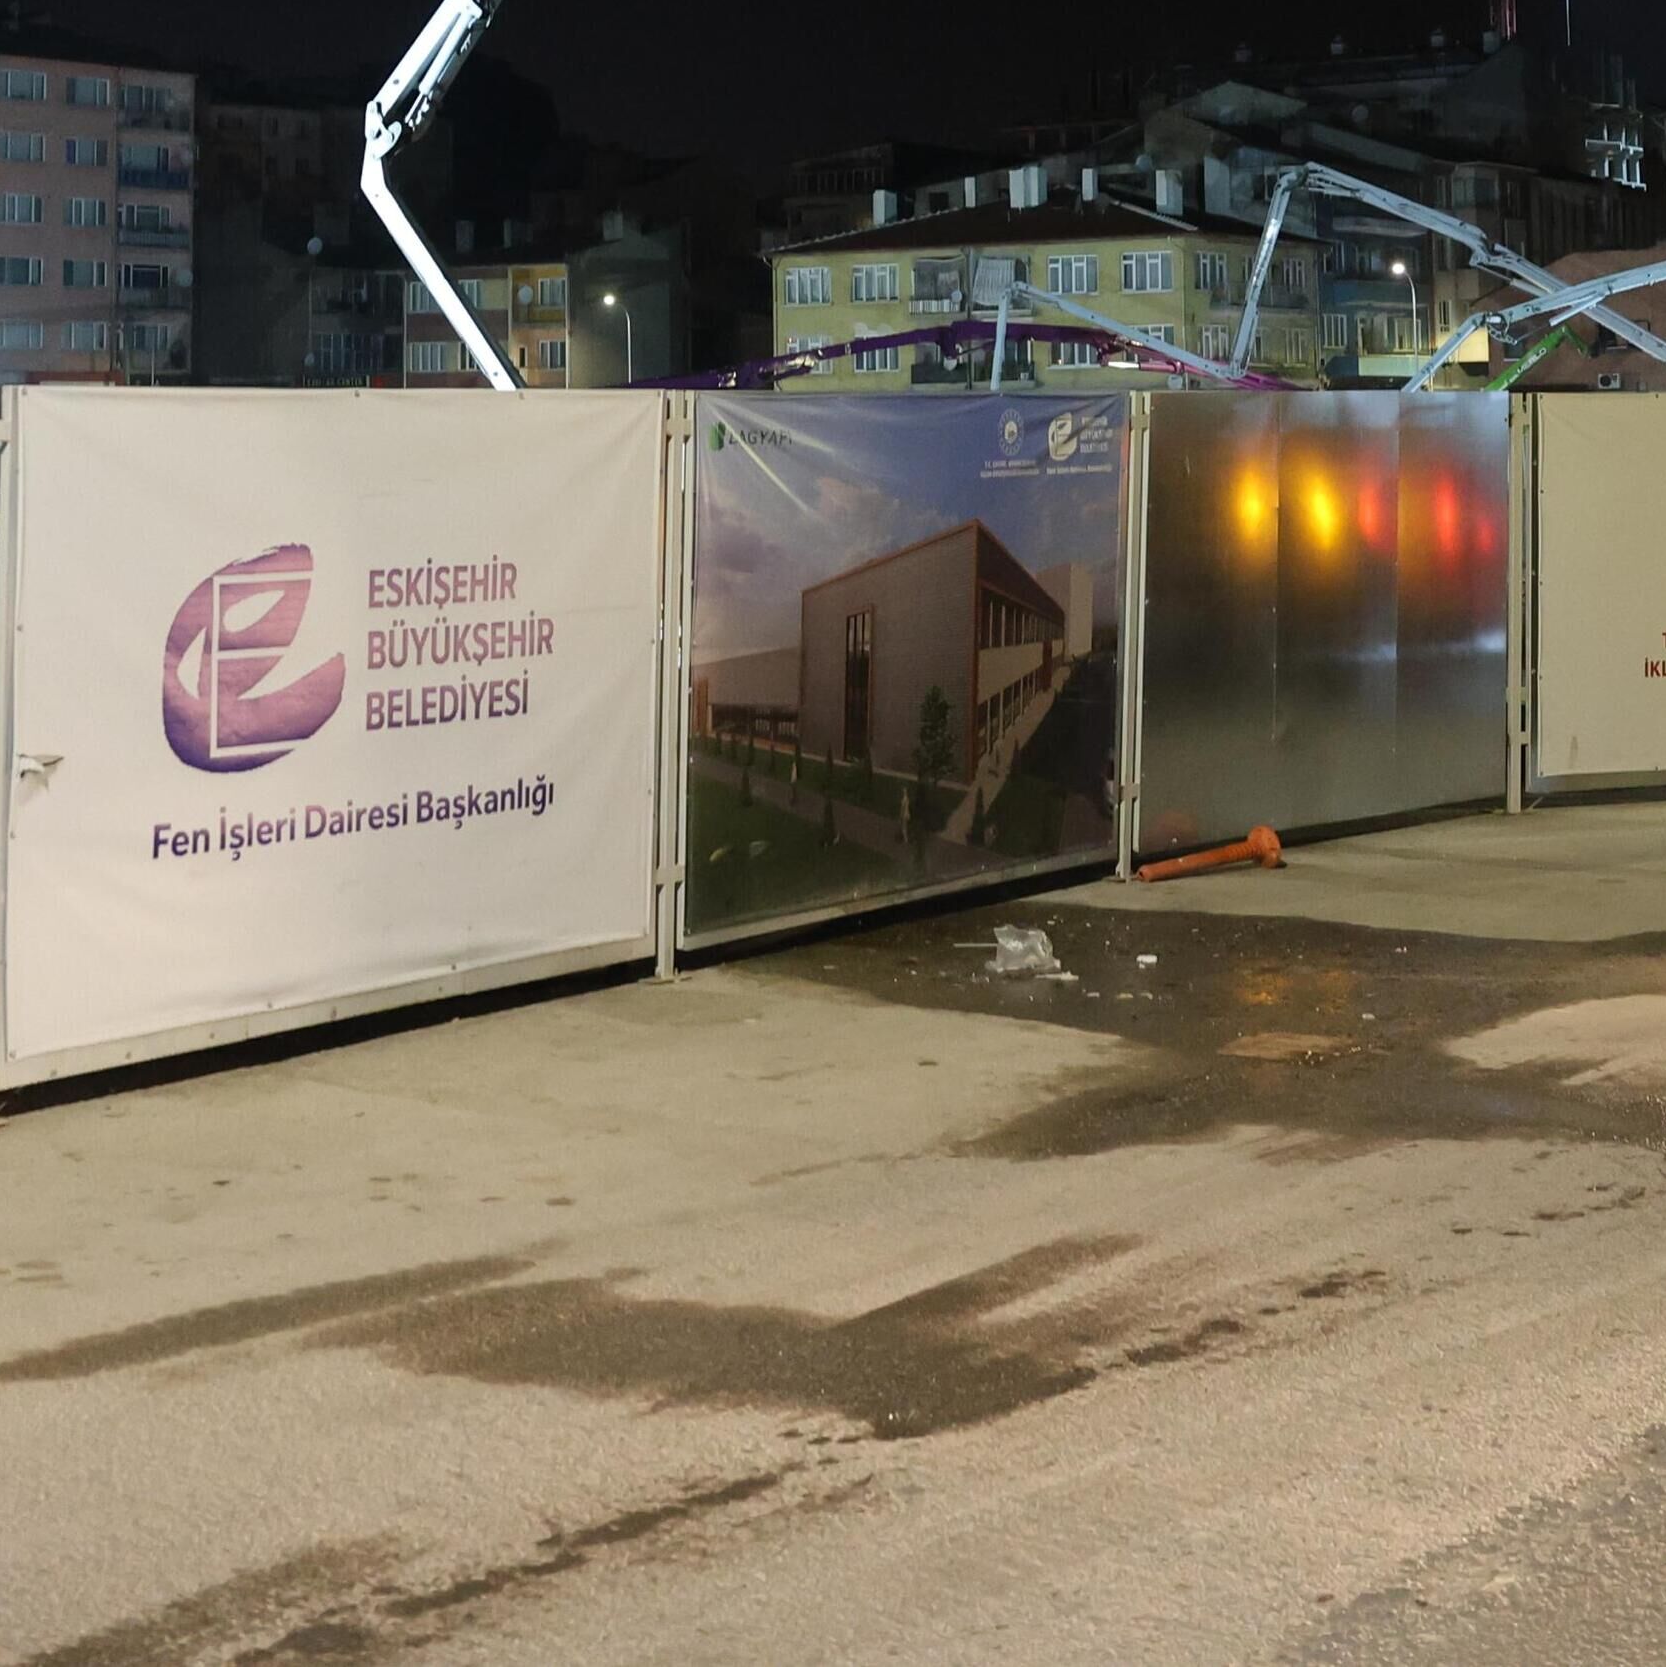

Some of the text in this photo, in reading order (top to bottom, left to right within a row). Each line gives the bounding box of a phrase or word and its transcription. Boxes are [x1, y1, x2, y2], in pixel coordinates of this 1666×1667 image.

[367, 554, 518, 610] ESKİŞEHİR
[367, 609, 555, 672] BÜYÜKŞEHİR
[365, 669, 530, 731] BELEDİYESİ
[151, 773, 556, 861] Fen İşleri Dairesi Başkanlığı
